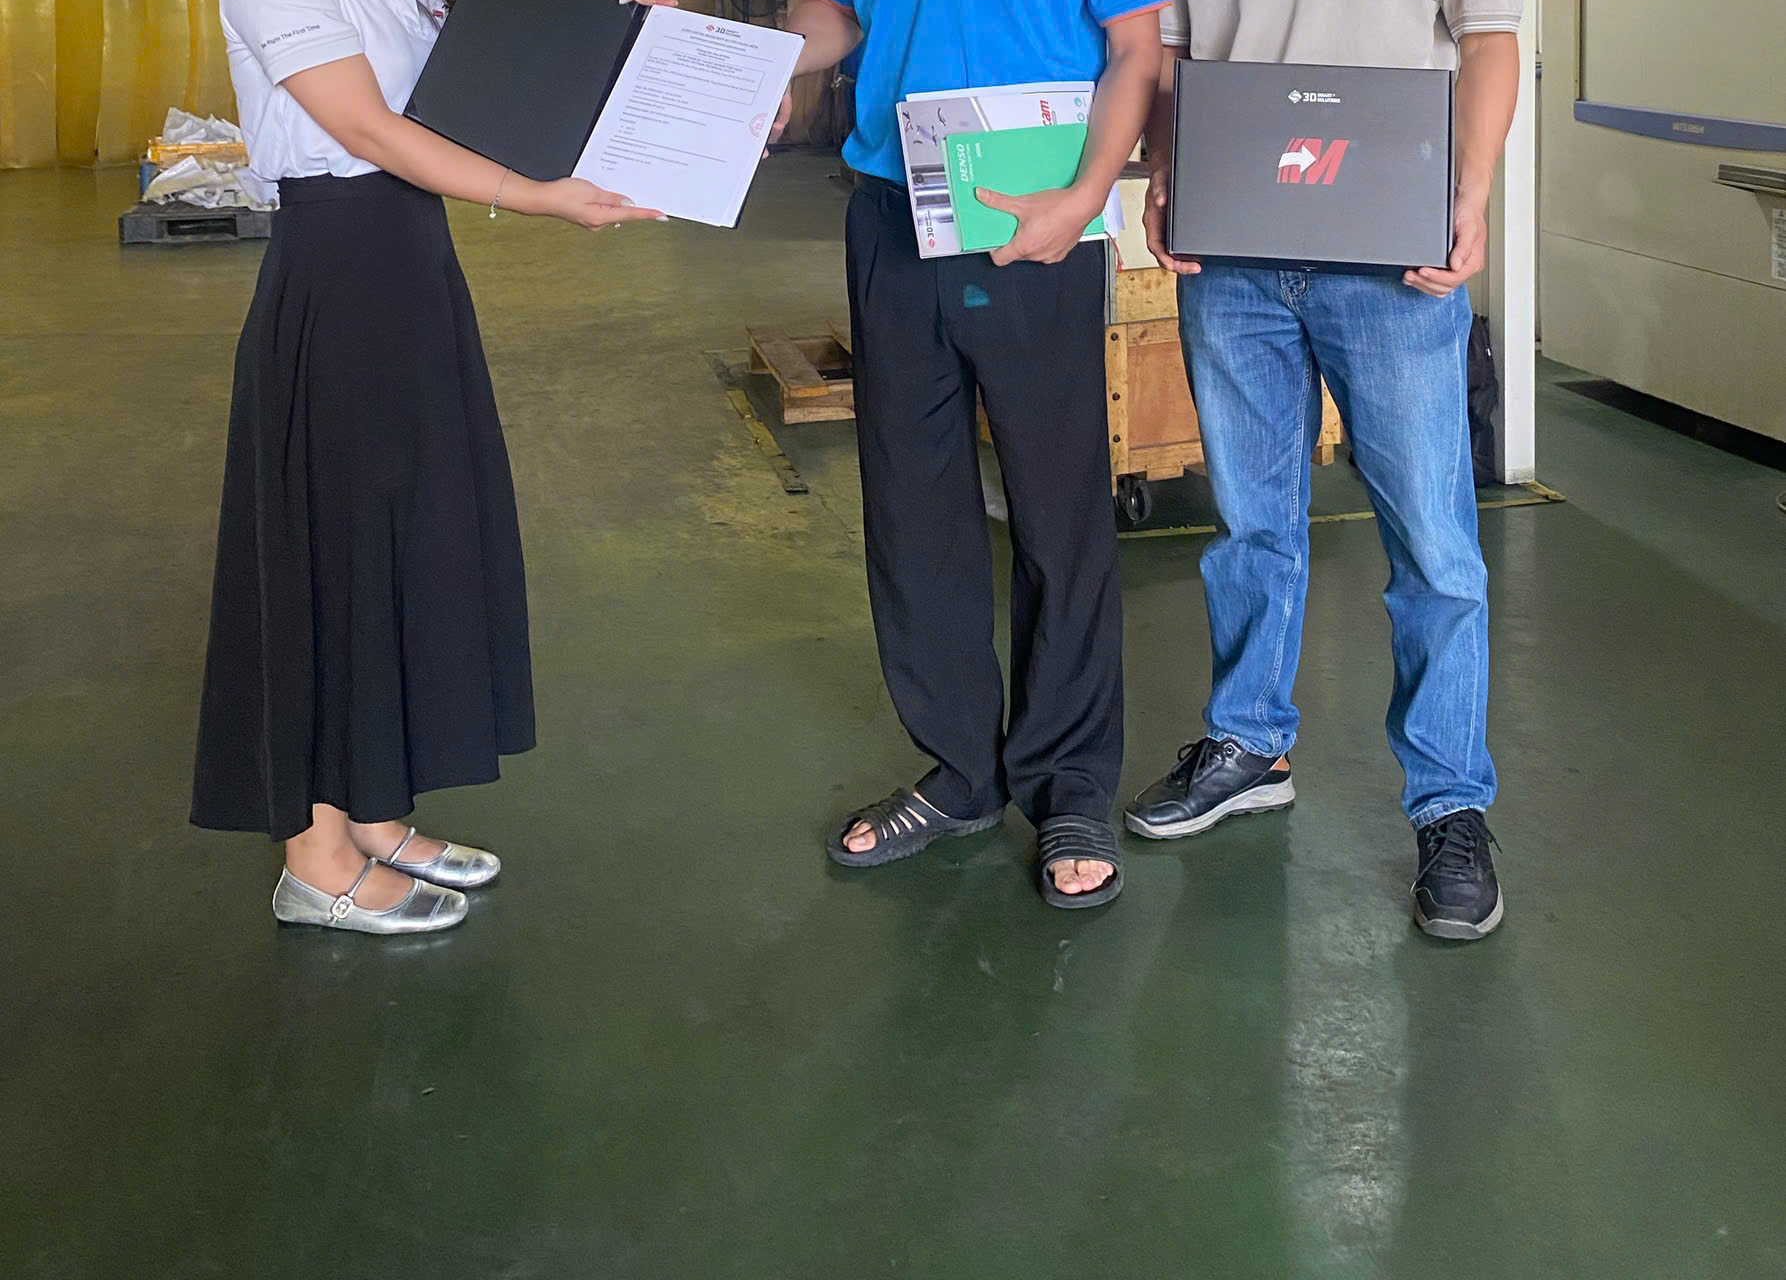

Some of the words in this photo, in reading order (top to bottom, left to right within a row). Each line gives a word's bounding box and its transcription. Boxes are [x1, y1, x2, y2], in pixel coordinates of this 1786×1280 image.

[281, 32, 292, 40] The
[292, 27, 306, 36] First
[306, 24, 320, 32] Time
[956, 143, 969, 183] DENSO
